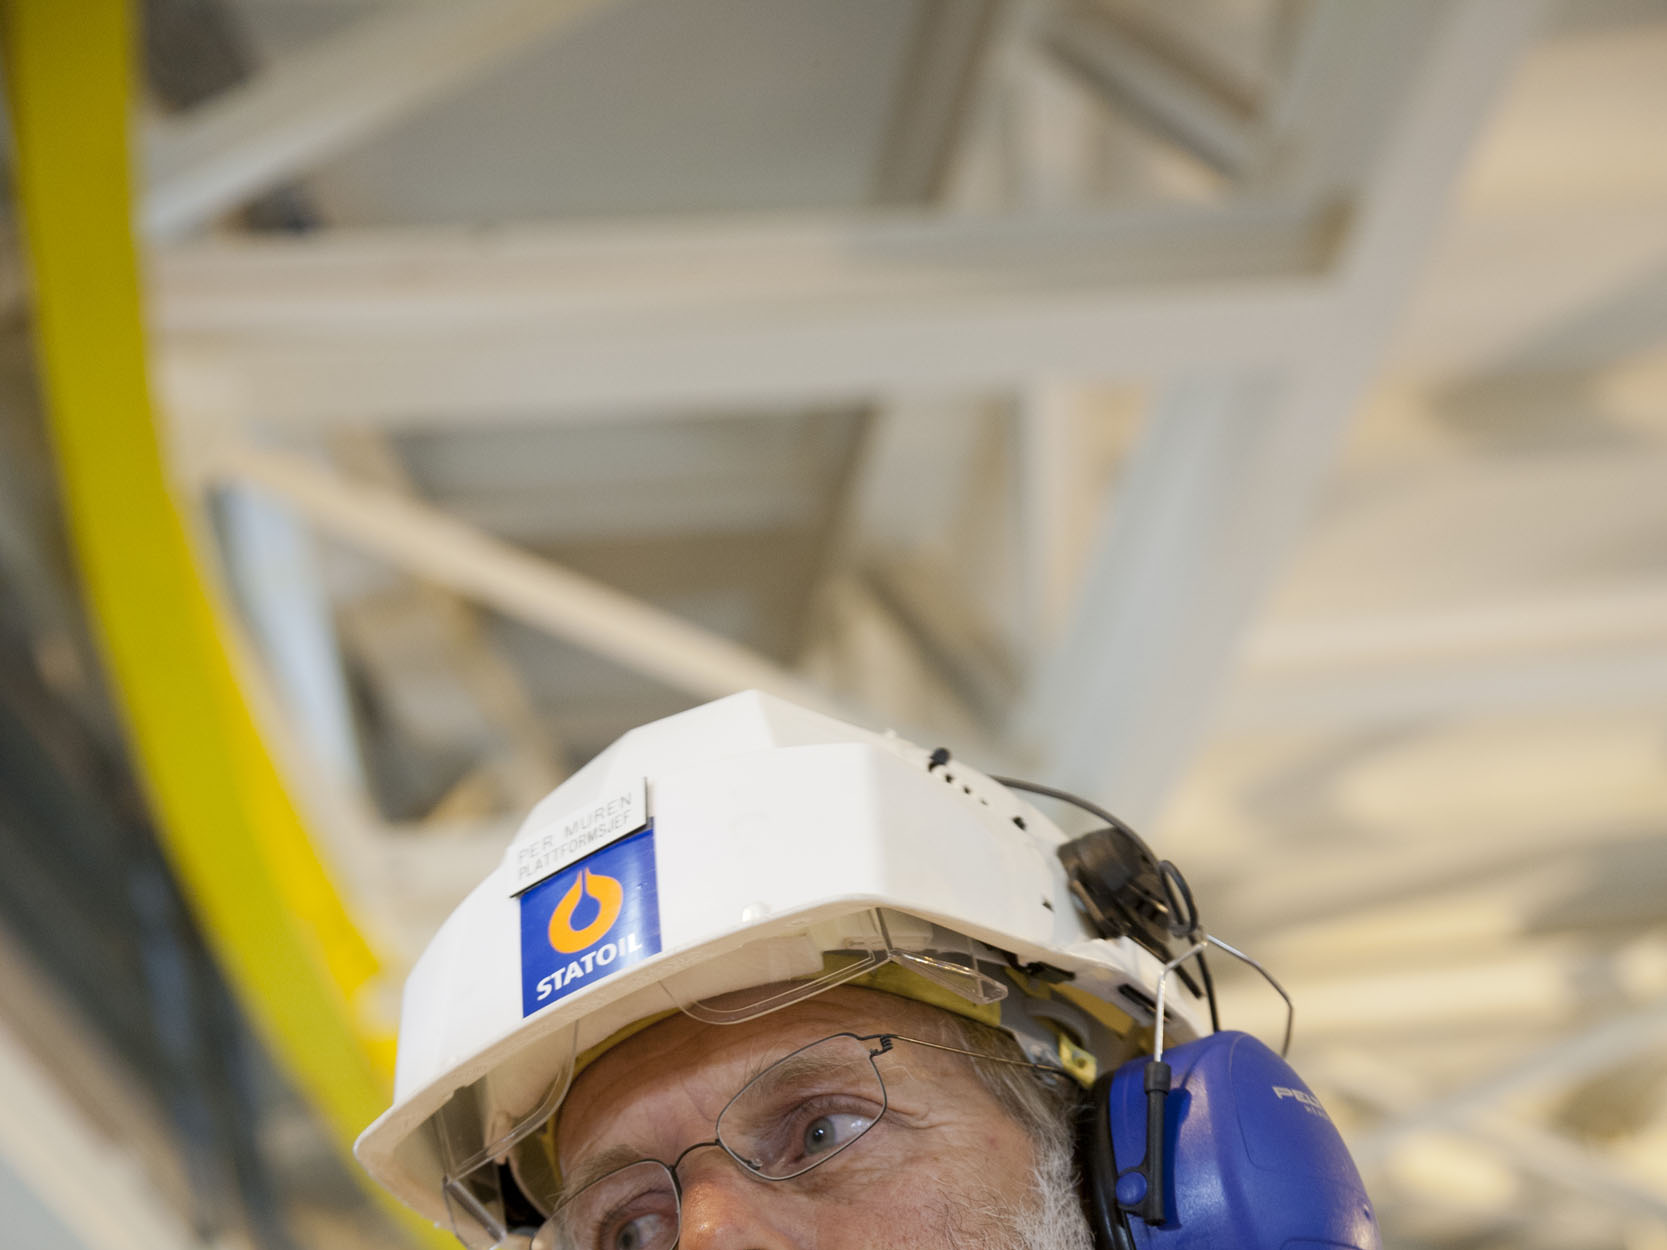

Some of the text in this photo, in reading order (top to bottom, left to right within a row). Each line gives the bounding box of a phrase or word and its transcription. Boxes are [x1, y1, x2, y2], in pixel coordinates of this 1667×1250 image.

[518, 792, 633, 861] PER MUREN
[518, 809, 632, 881] PLATTFORMSJEF
[536, 932, 643, 1002] STATOIL
